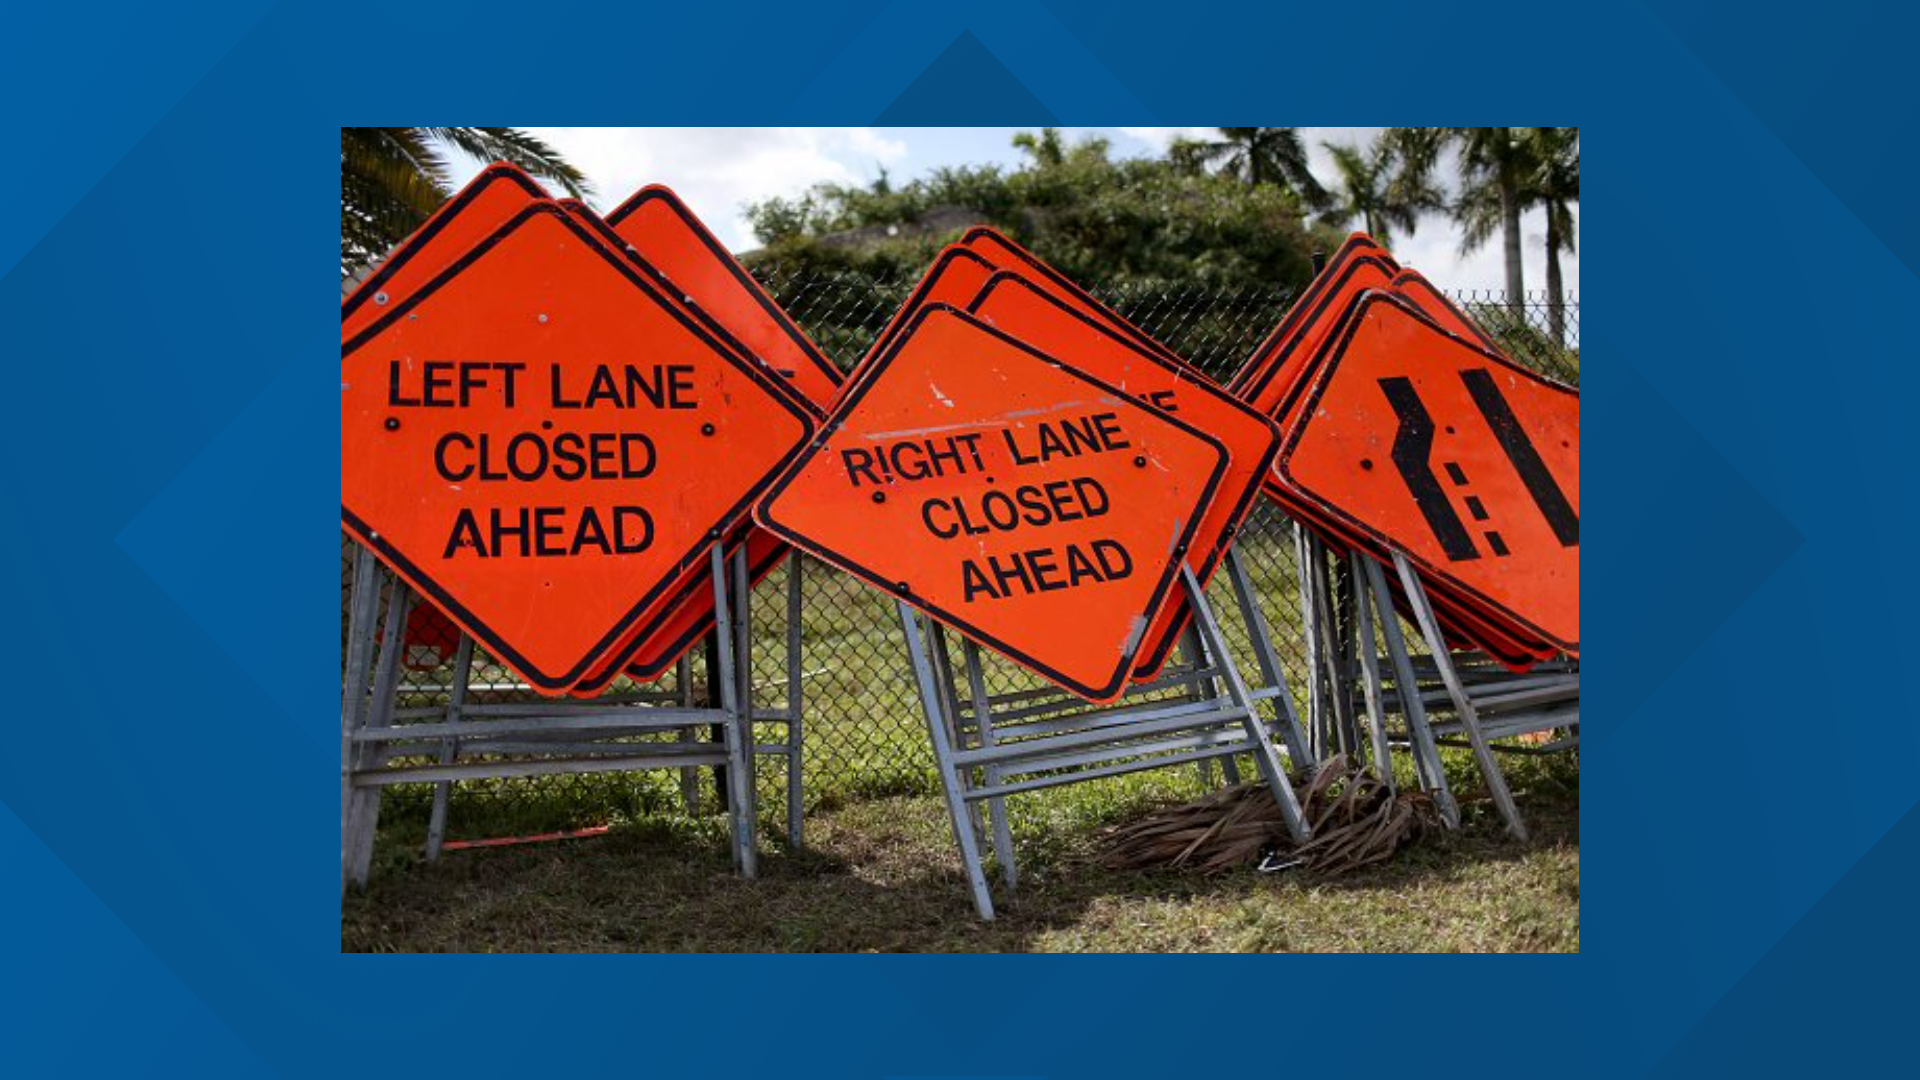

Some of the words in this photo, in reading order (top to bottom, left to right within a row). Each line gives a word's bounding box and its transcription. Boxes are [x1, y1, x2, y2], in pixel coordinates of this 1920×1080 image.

[388, 360, 526, 409] LEFT
[551, 363, 698, 410] LANE
[434, 431, 657, 483] CLOSED
[840, 432, 985, 487] RIGHT
[1002, 412, 1131, 466] LANE
[442, 505, 656, 559] AHEAD
[922, 476, 1109, 540] CLOSED
[962, 539, 1134, 603] AHEAD
